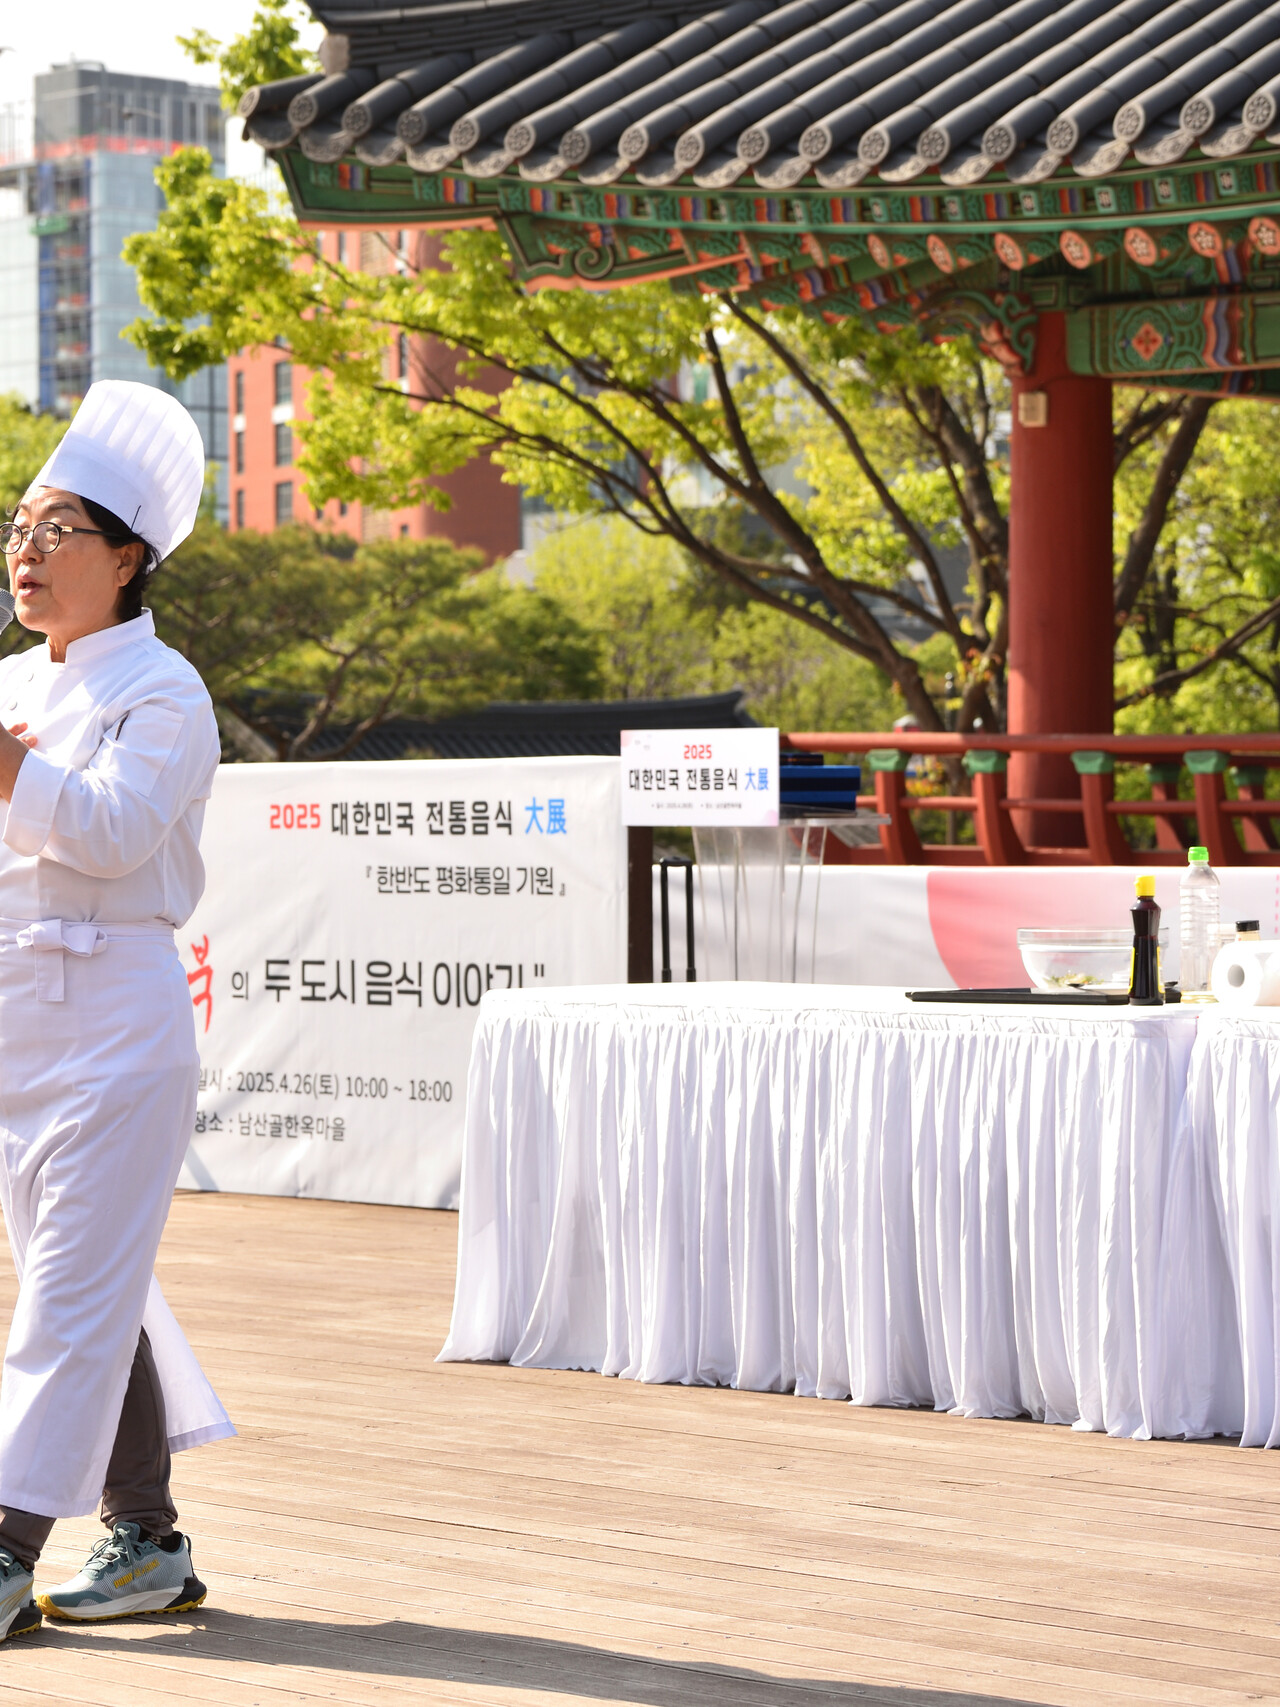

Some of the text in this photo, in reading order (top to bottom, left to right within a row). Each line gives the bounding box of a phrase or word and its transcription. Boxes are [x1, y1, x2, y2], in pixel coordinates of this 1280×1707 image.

[684, 745, 712, 759] 2025
[628, 767, 769, 791] 대한민국 전통음식 大展
[270, 797, 567, 836] 2025 대한민국 전통음식 大展
[436, 865, 511, 896] 평화통일
[231, 970, 250, 1001] 의
[264, 959, 291, 1003] 두
[300, 959, 356, 1004] 도시
[365, 960, 423, 1008] 음식
[236, 1070, 340, 1101] 2025.4.26(토)
[345, 1076, 389, 1099] 10:00
[408, 1079, 453, 1103] 18:00
[238, 1111, 347, 1142] 남산골한옥마을
